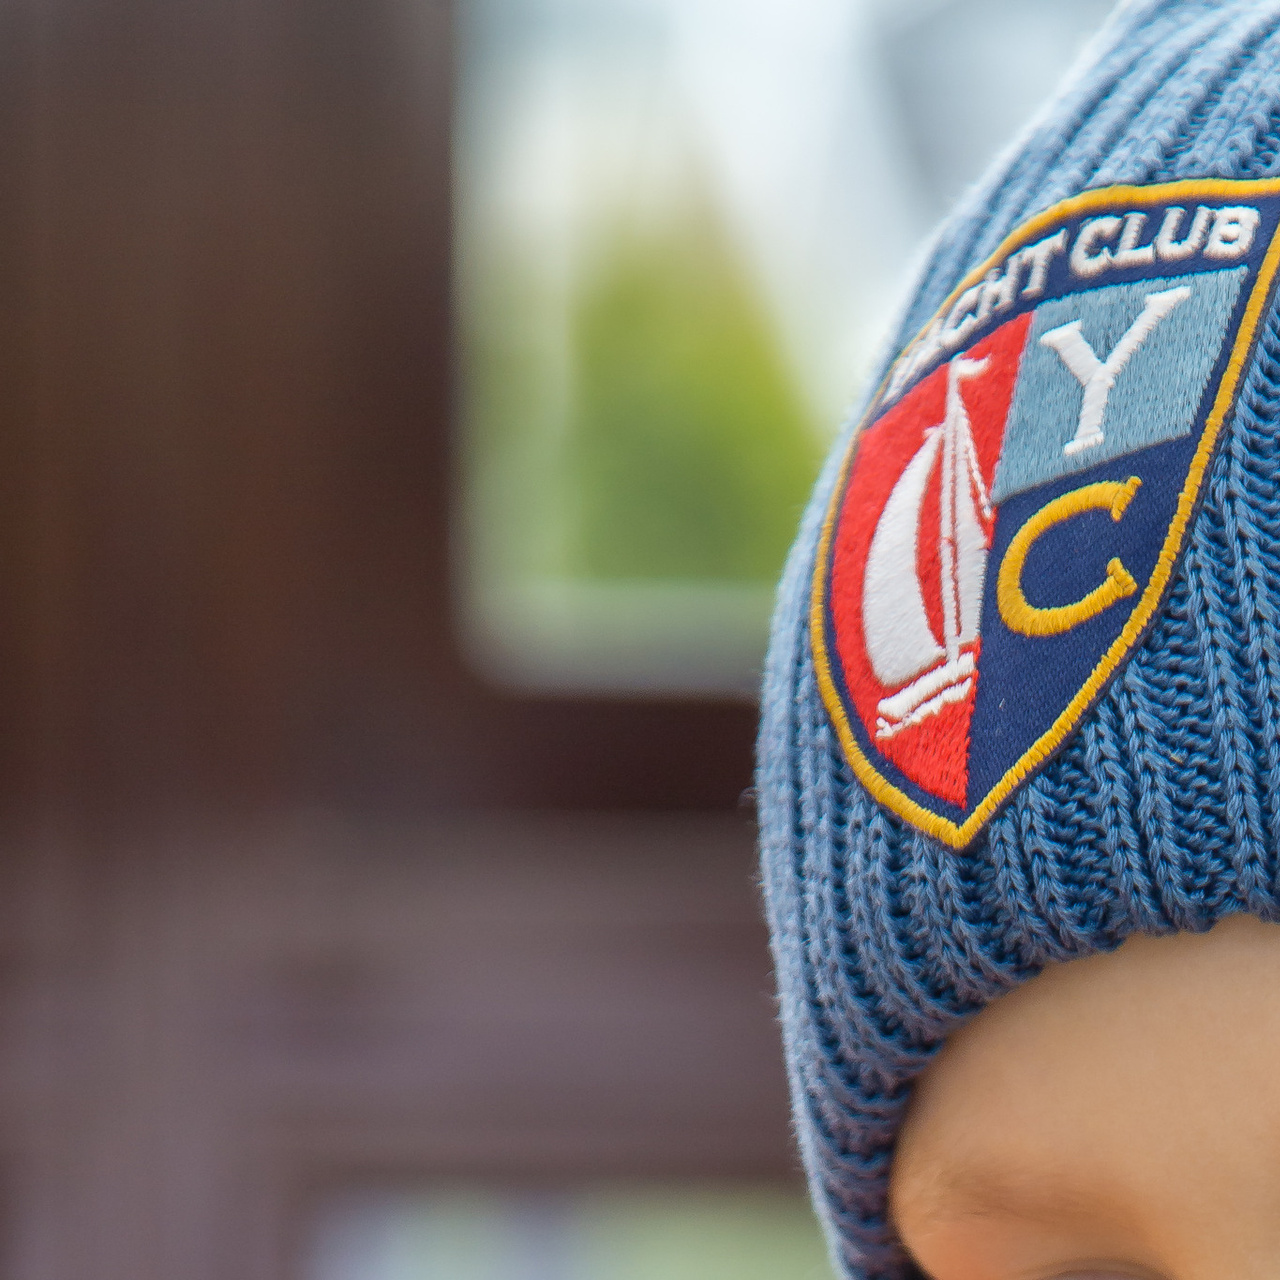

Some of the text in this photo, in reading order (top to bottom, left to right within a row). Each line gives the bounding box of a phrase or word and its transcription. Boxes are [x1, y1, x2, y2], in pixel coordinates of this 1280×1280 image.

[881, 204, 1261, 405] CHT CLUB
[1040, 286, 1192, 456] Y
[996, 476, 1143, 638] C
